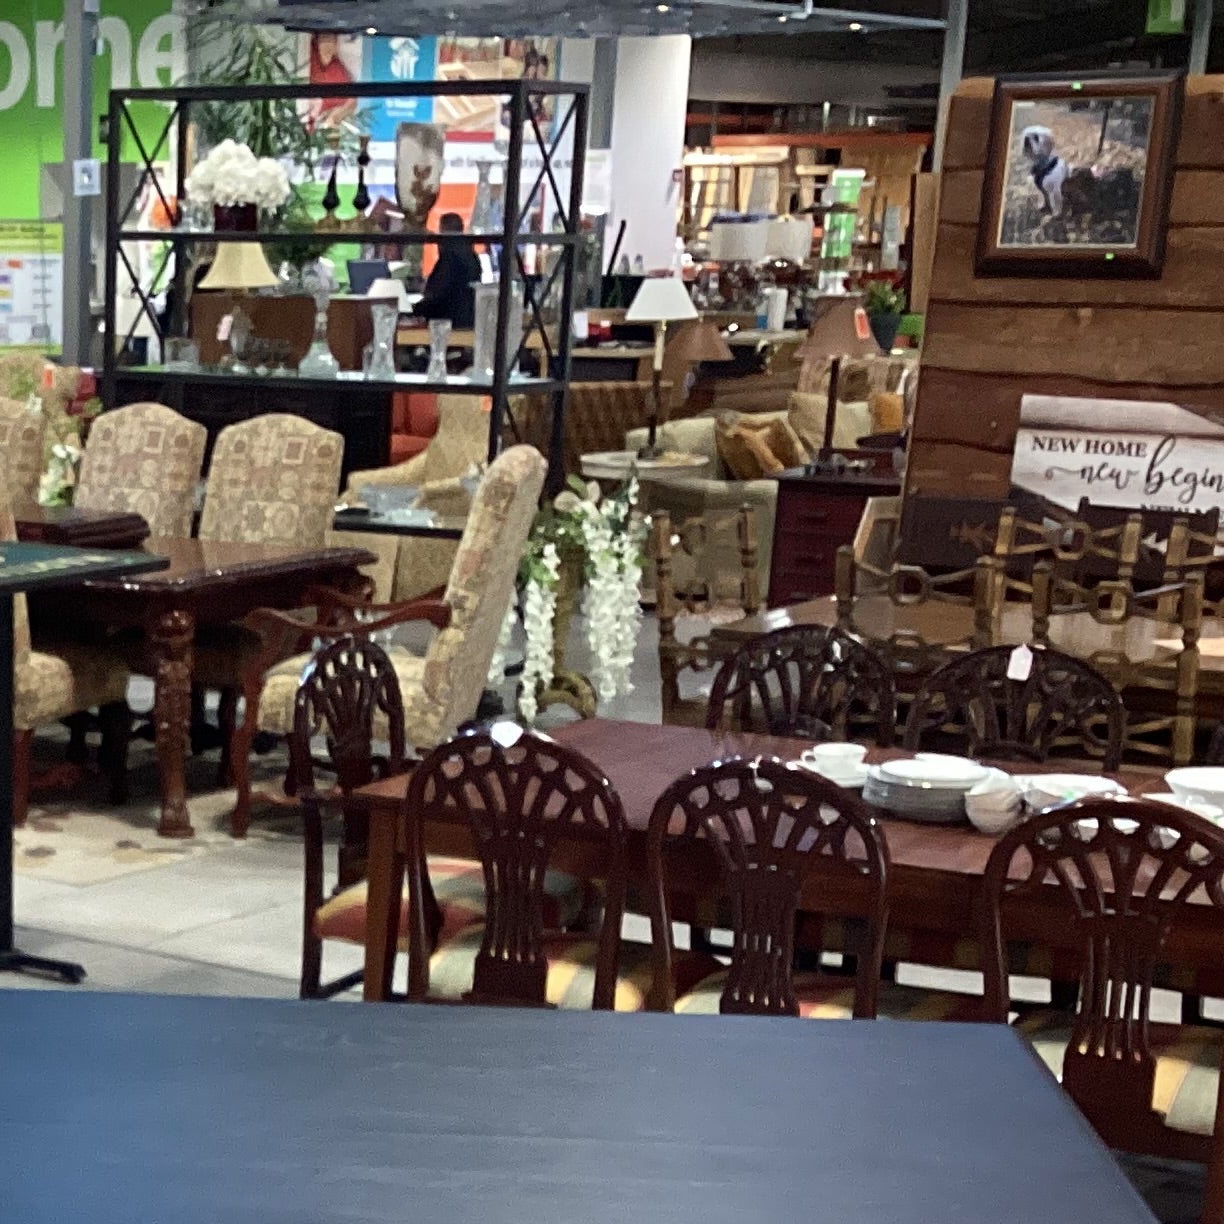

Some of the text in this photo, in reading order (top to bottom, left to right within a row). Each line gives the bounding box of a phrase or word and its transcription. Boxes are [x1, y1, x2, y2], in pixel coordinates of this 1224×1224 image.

[1031, 435, 1147, 458] NEW HOME
[1080, 461, 1140, 490] new
